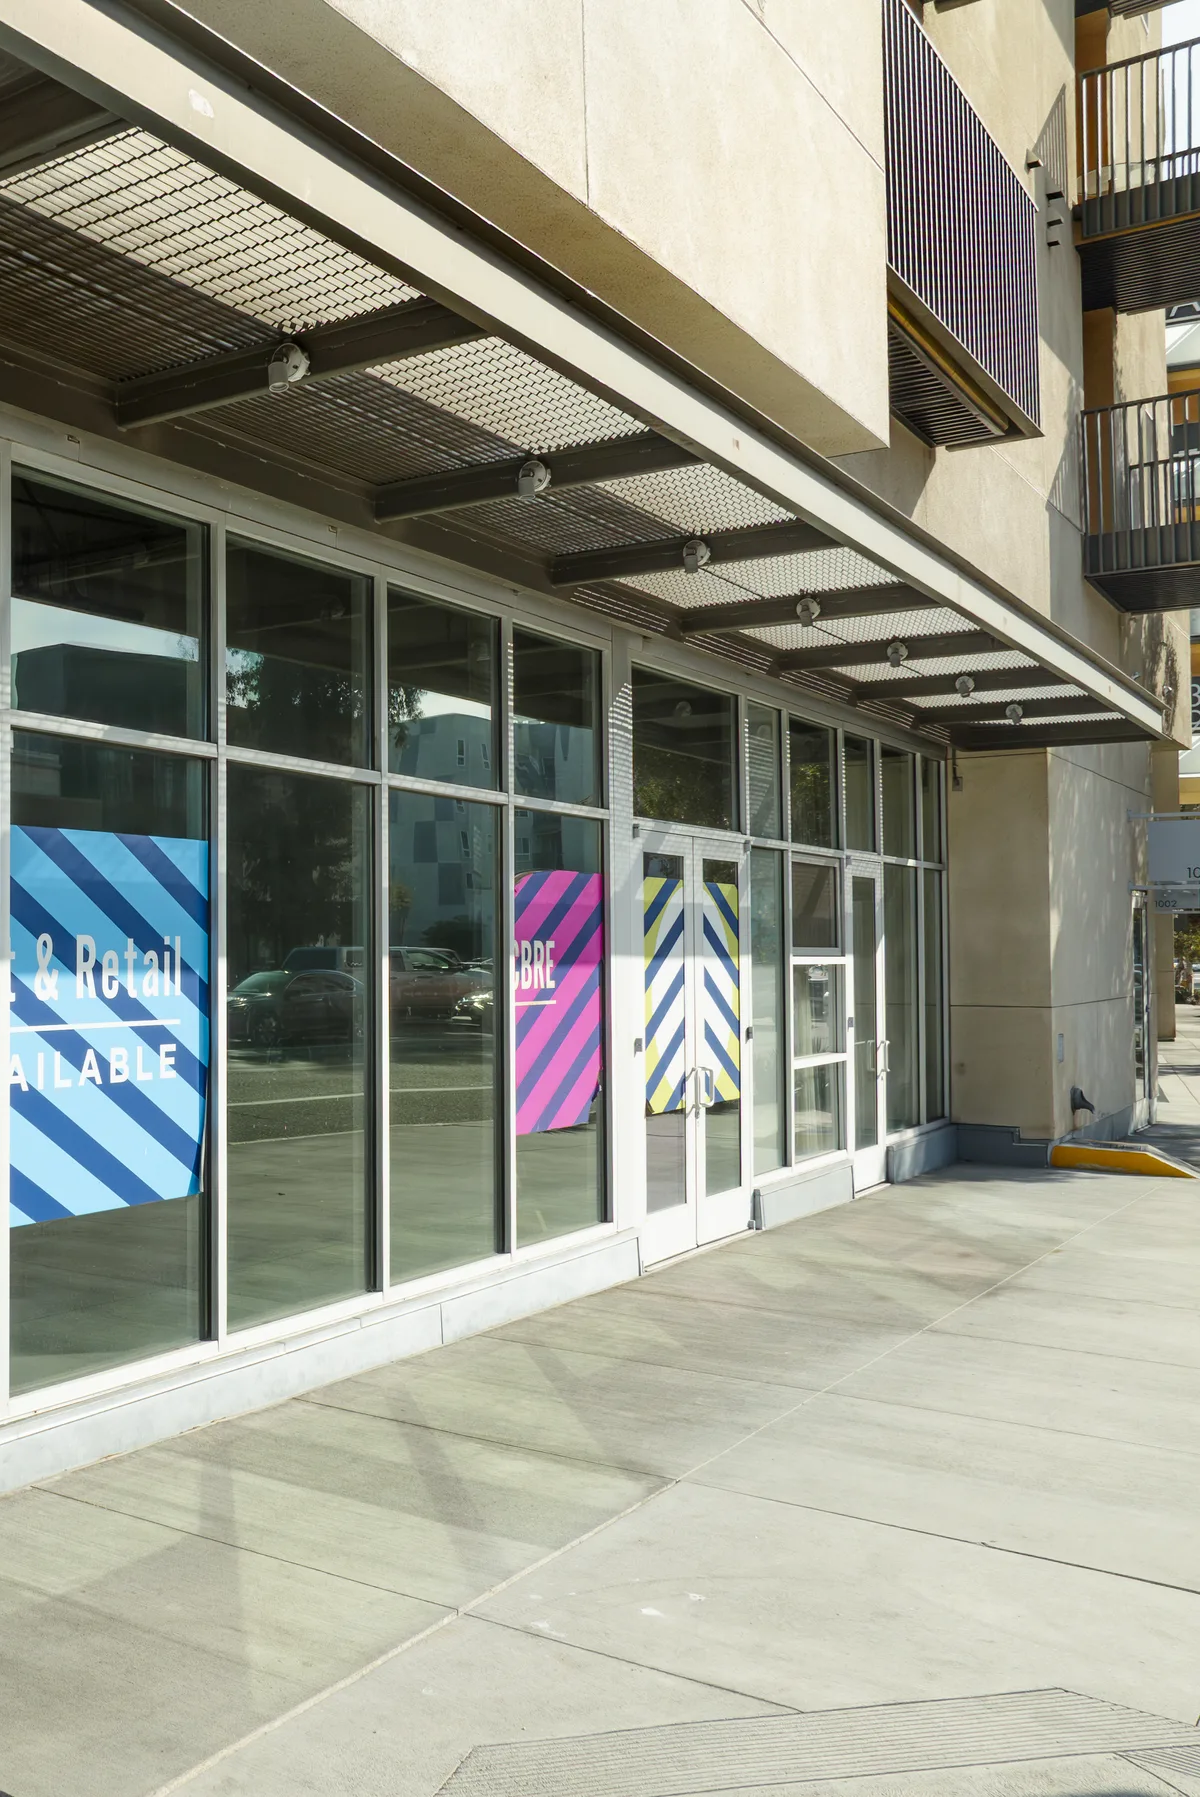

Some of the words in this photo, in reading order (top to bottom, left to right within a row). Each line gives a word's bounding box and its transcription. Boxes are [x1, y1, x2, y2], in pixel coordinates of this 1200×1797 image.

[1154, 900, 1177, 908] 1002
[33, 932, 59, 1002] &
[75, 934, 182, 1000] Retail
